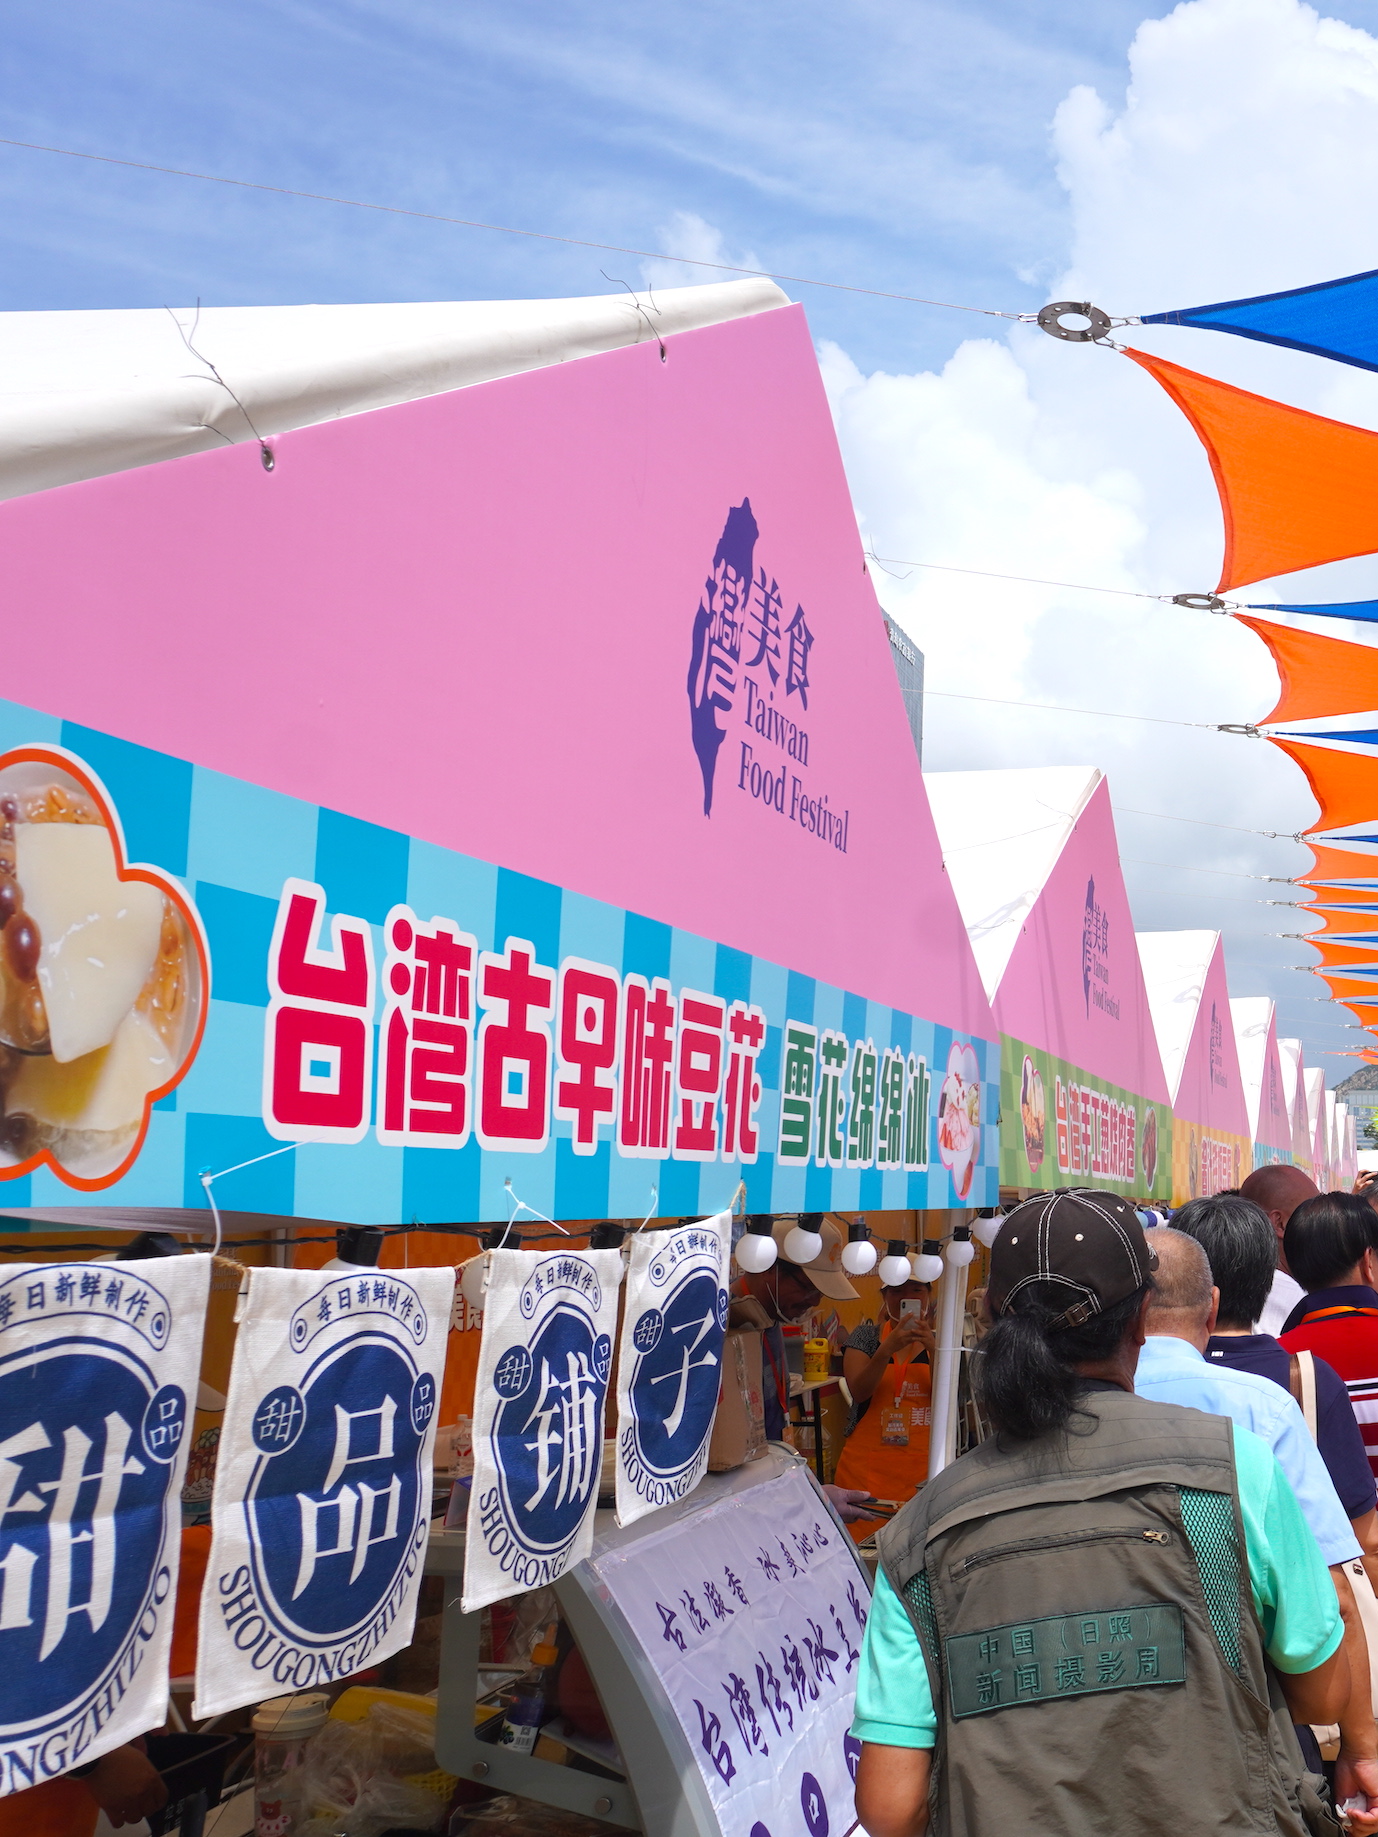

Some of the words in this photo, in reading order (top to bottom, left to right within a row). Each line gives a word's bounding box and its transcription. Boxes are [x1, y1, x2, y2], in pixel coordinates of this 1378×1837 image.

[745, 566, 815, 711] 美食
[743, 676, 809, 767] Taiwan
[738, 741, 787, 814] Food
[789, 775, 850, 854] Festival
[270, 892, 767, 1156] 台湾古早味豆花
[780, 1027, 930, 1166] 雪花绵绵冰
[317, 1279, 414, 1322] 每日新鲜制作
[635, 1316, 661, 1346] 甜
[256, 1396, 302, 1443] 甜
[414, 1383, 434, 1423] 品
[497, 1352, 530, 1391] 甜
[650, 1307, 719, 1440] 子
[150, 1398, 183, 1450] 品
[523, 1350, 598, 1513] 铺
[291, 1393, 403, 1602] 品
[219, 1517, 428, 1689] SHOUGONGZHIZUO
[0, 1564, 171, 1796] NGZHIZUO
[975, 1645, 1161, 1704] 新闻摄影周
